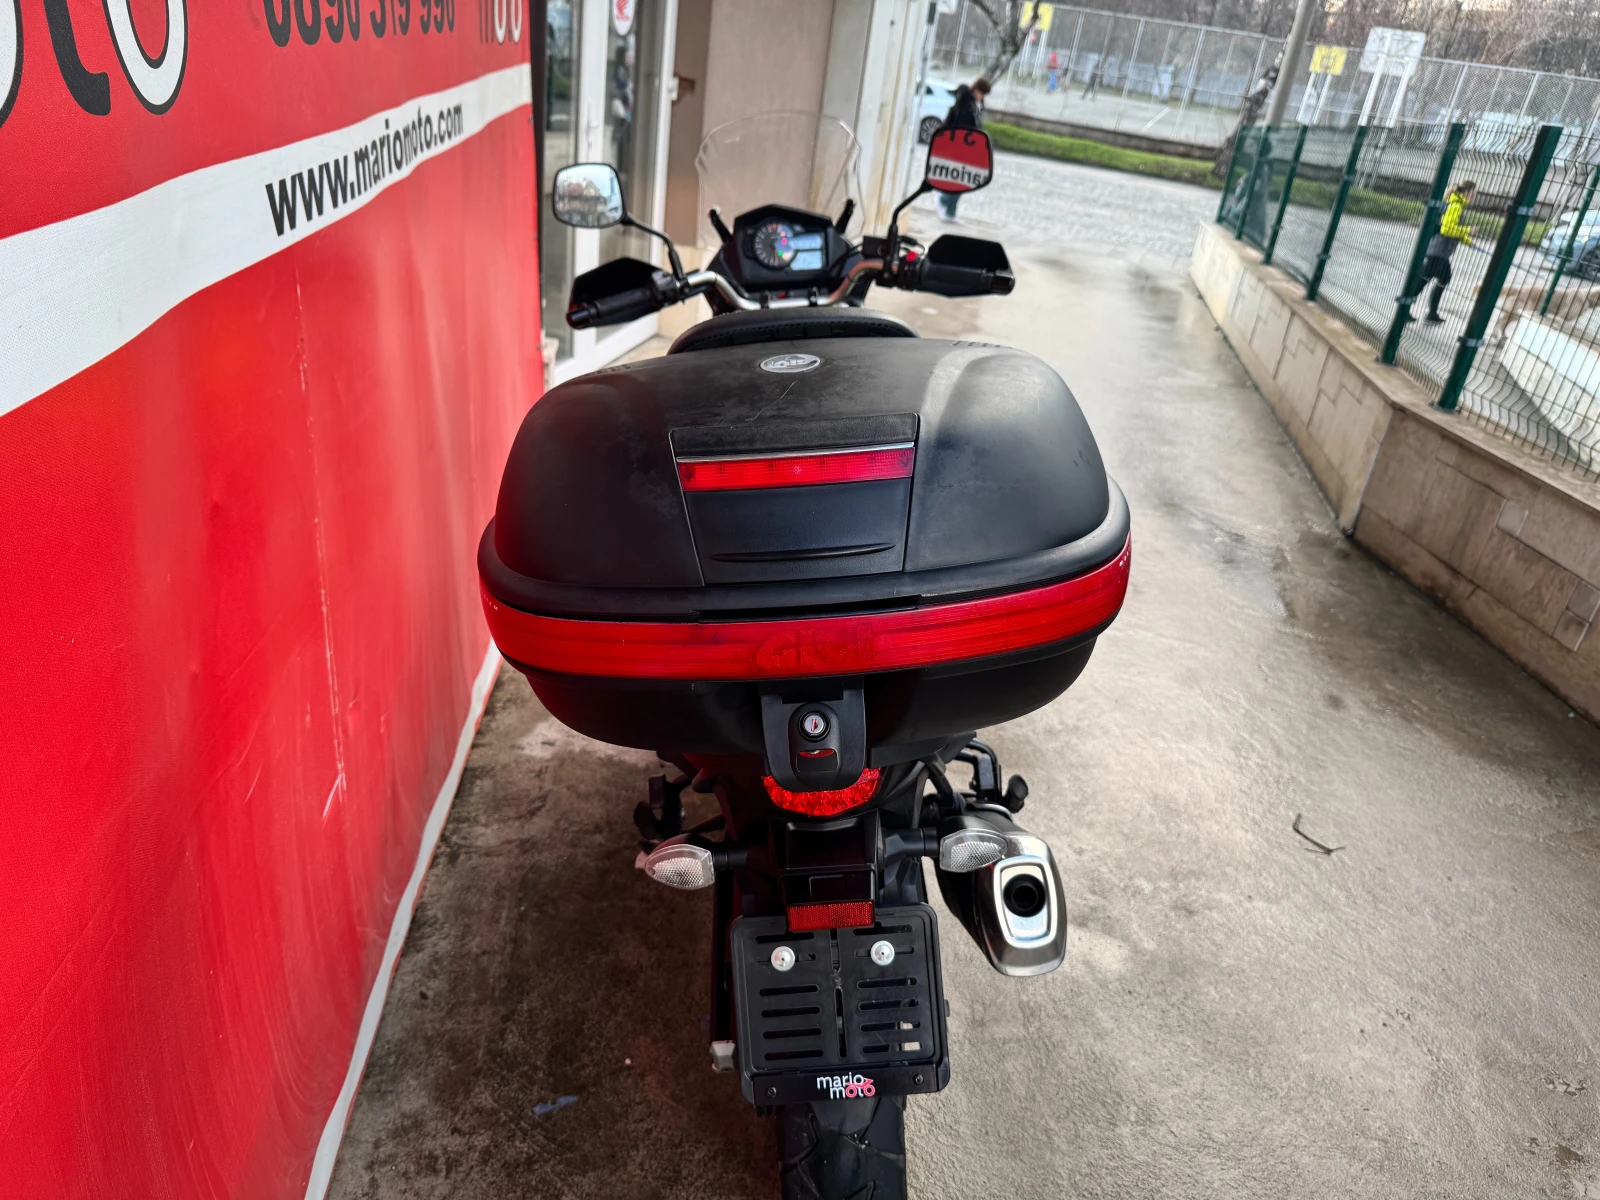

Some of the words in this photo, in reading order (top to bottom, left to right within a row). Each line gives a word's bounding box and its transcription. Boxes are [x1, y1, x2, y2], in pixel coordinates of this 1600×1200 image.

[265, 103, 464, 237] www.mariomoto.com
[816, 1071, 864, 1090] mario
[829, 1085, 876, 1100] moto
